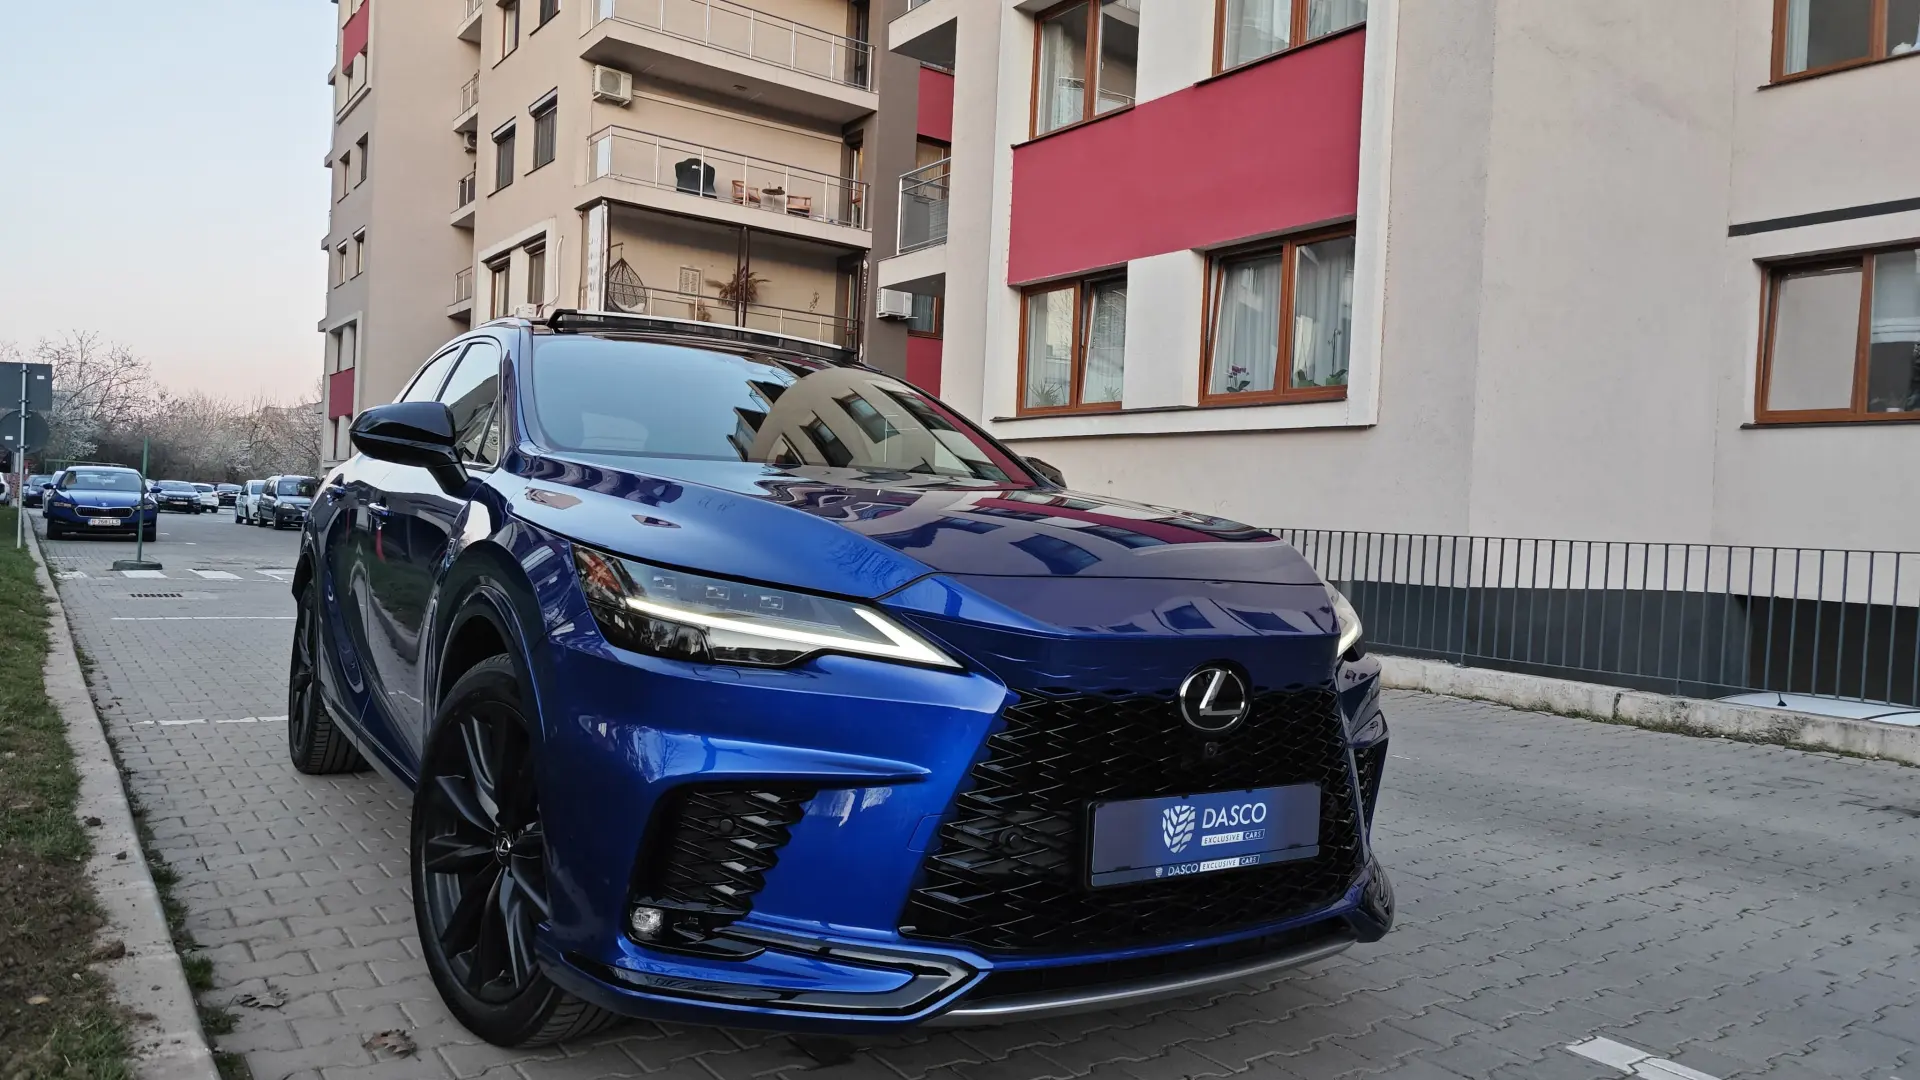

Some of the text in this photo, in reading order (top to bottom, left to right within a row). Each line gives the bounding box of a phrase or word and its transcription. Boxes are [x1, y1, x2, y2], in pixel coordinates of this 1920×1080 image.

[1202, 802, 1267, 828] DASCO
[1204, 831, 1261, 845] EXCLUSIVE CARS
[1168, 856, 1257, 876] DASCO EXCLUSIVE CARS
